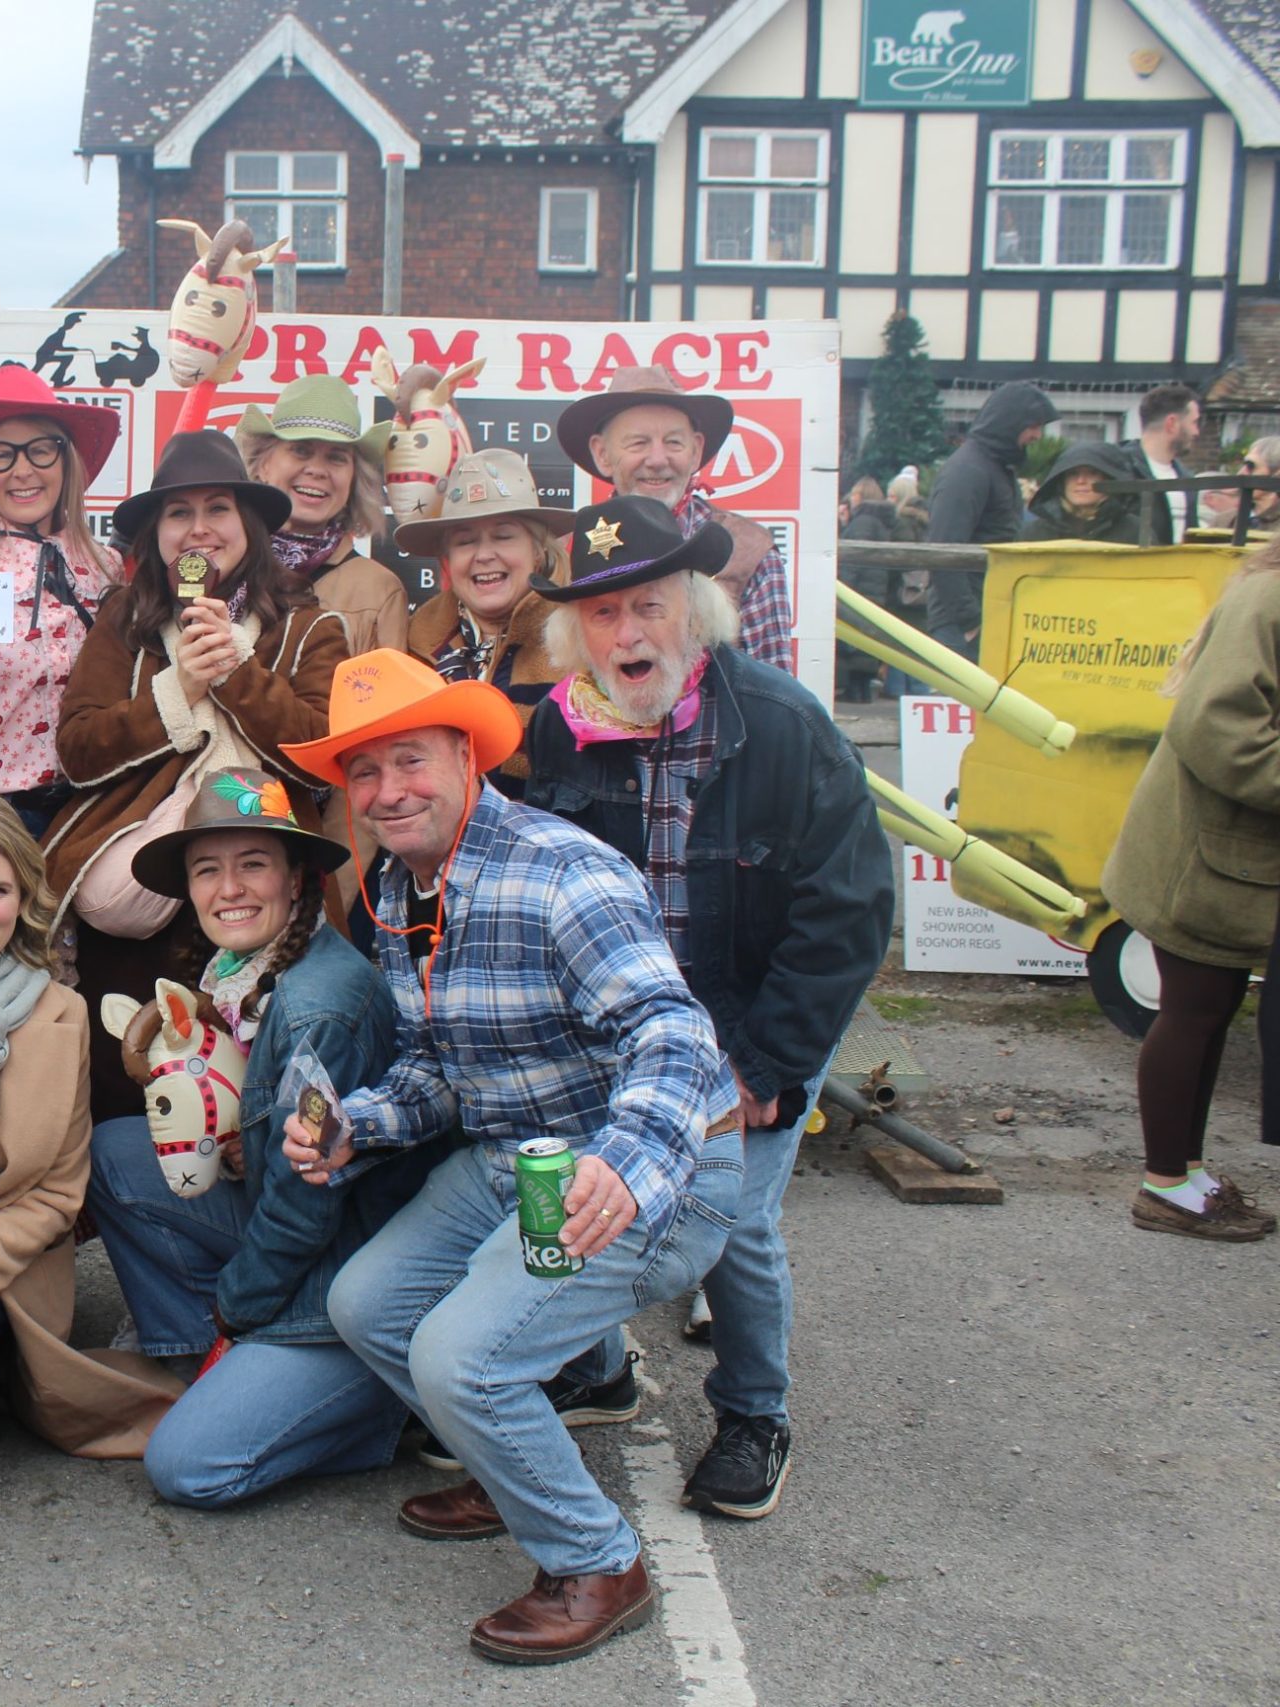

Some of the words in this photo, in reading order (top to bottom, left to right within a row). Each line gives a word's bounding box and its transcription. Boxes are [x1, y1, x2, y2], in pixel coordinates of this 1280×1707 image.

[872, 36, 945, 66] Bear
[516, 330, 773, 392] RACE
[1023, 613, 1097, 636] TROTTERS
[1022, 637, 1112, 666] INDEPENDENT
[1113, 638, 1177, 668] TRADING
[927, 906, 955, 918] NEW
[957, 907, 989, 918] BARN
[922, 922, 995, 934] SHOWROOM
[916, 937, 967, 949] BOGNOR
[969, 938, 1001, 950] REGIS
